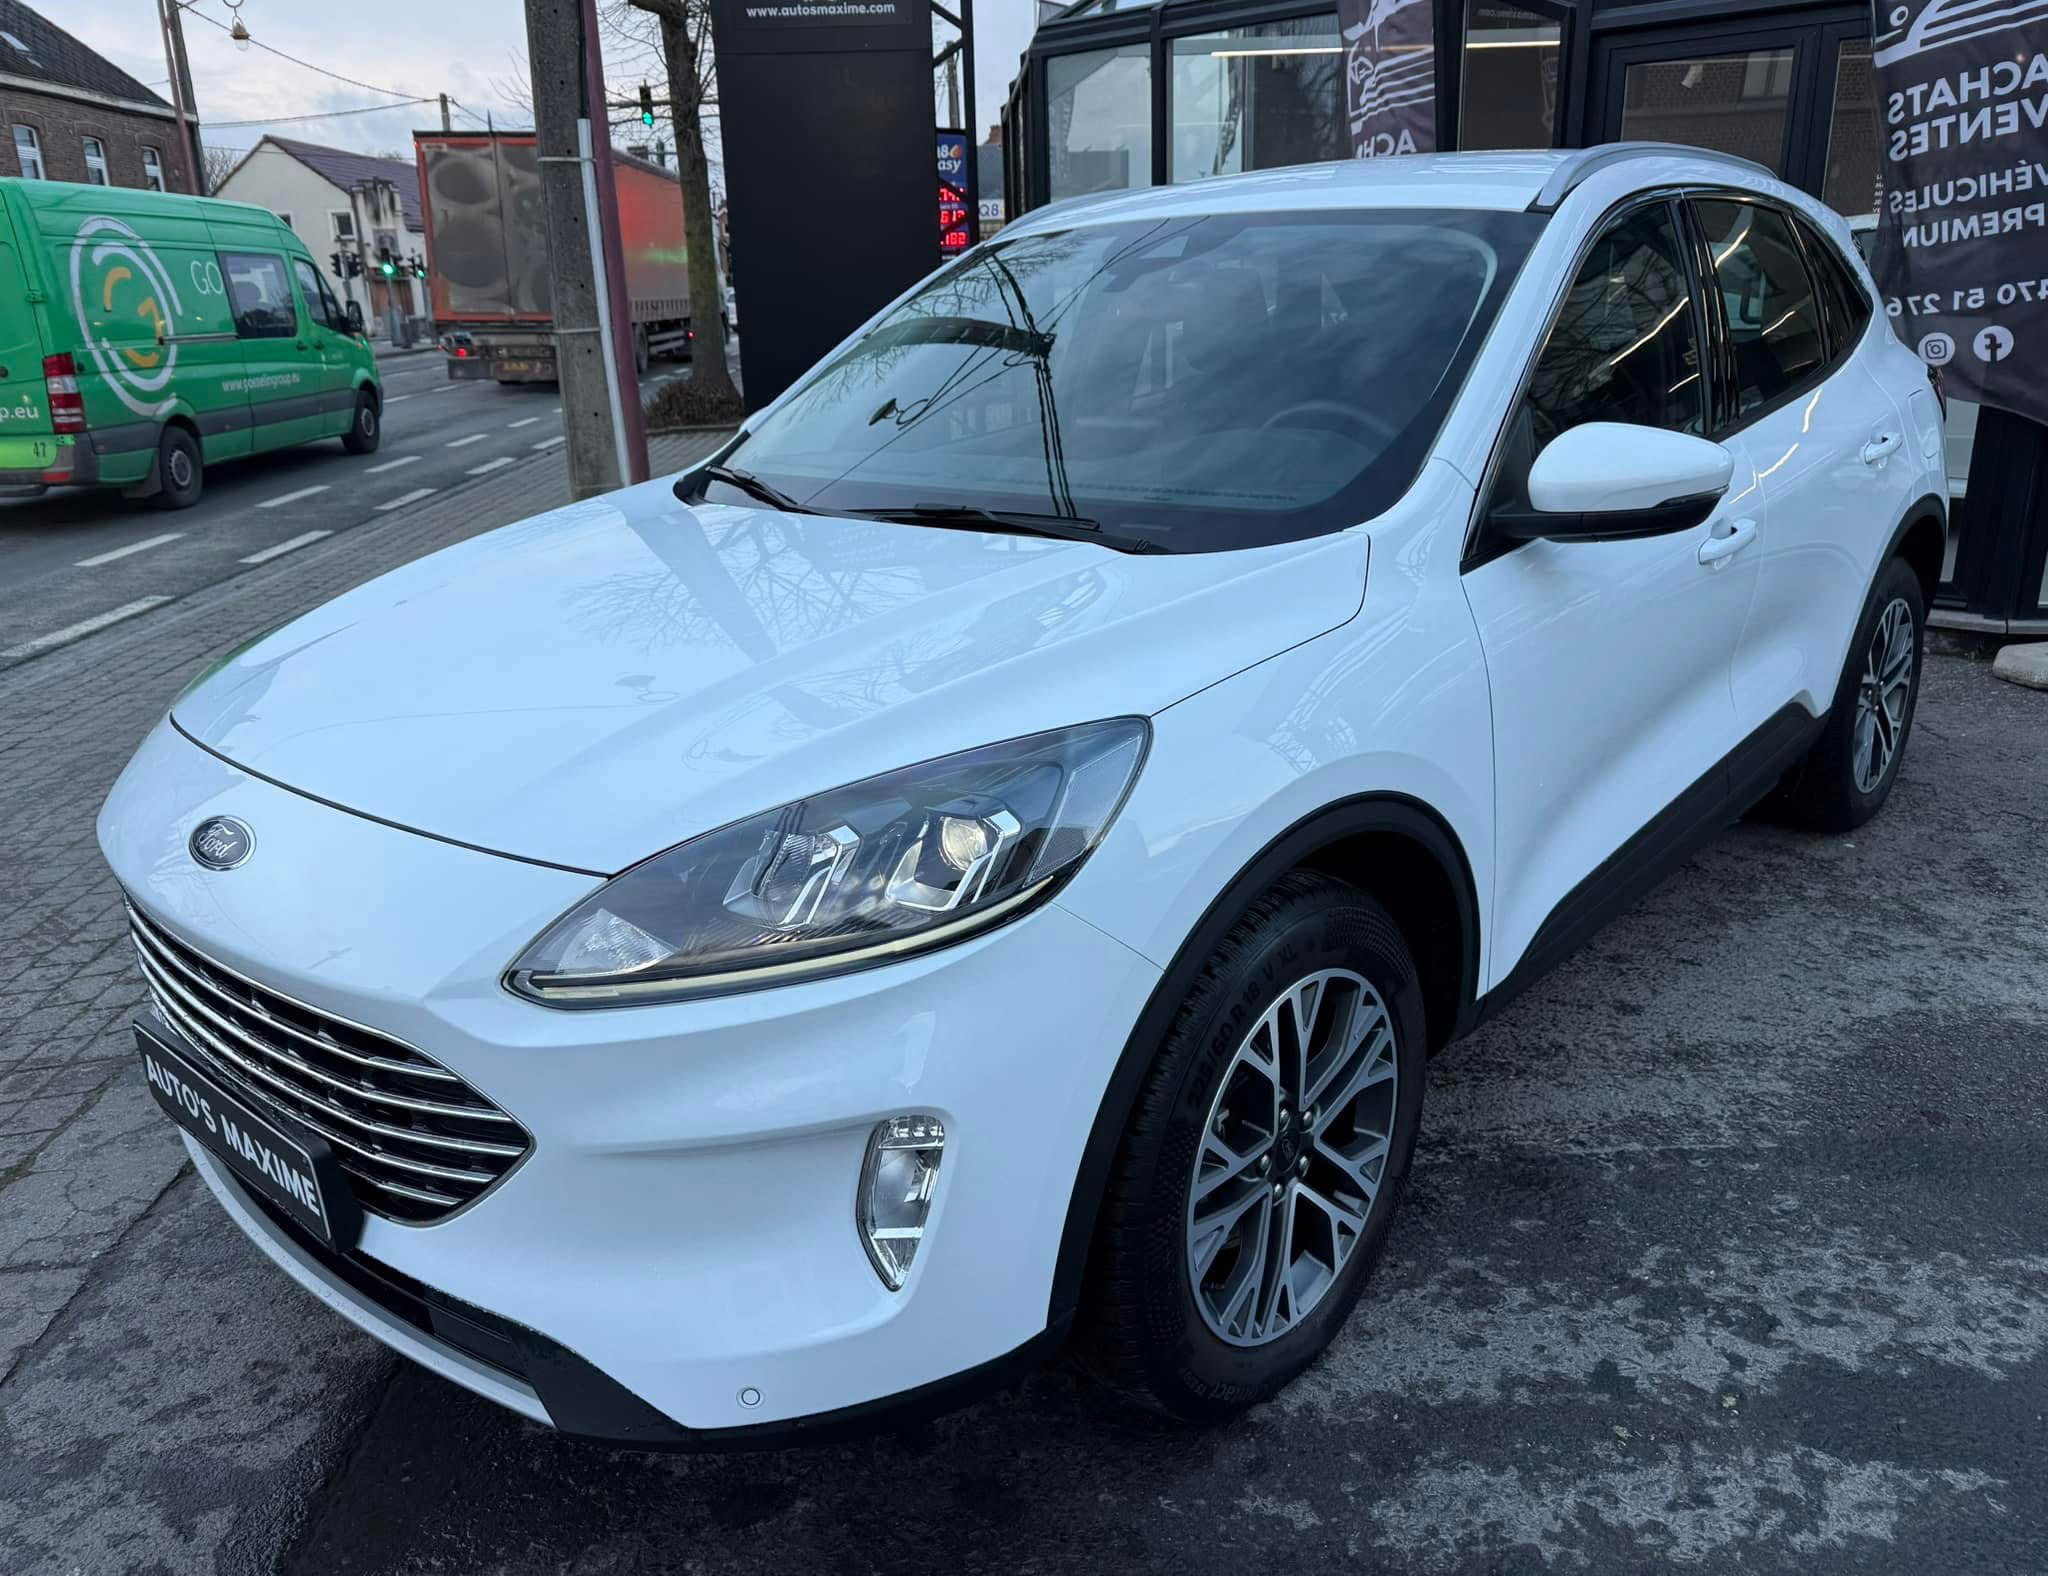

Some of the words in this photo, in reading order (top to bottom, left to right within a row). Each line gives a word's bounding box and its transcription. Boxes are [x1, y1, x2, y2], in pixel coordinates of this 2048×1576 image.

[746, 2, 895, 17] www.autosmaxime.com
[937, 160, 961, 174] asy
[980, 203, 999, 216] Q8
[145, 1053, 217, 1133] AUTO'S
[220, 1113, 321, 1217] MAXIME
